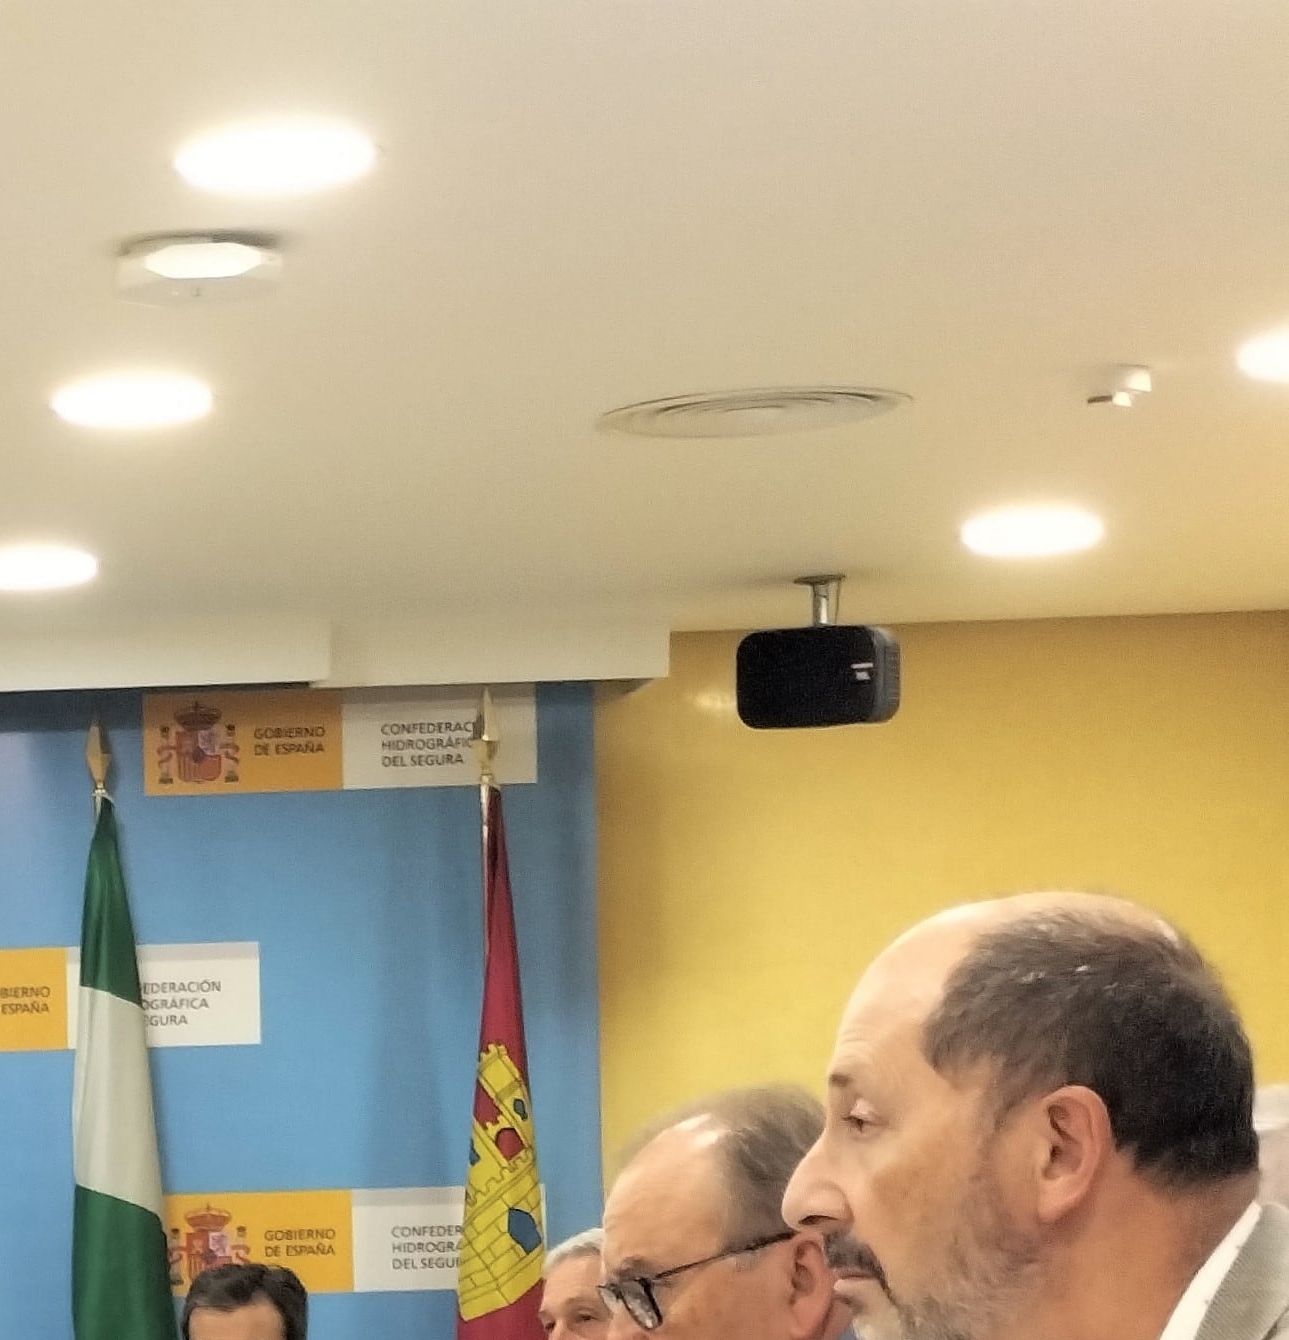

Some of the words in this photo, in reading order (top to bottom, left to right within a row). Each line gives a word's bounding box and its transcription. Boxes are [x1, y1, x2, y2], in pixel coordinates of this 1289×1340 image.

[254, 726, 325, 740] GOBIERNO
[381, 721, 473, 736] CONFEDERAC
[254, 744, 270, 756] DE
[275, 740, 325, 754] ESPAÑA
[382, 737, 473, 751] HIDROGRÁFIC
[382, 755, 407, 767] DEL
[411, 753, 463, 766] SEGURA
[143, 980, 221, 995] EDERACIÓN
[1, 1001, 49, 1015] ESPAÑA
[142, 998, 209, 1010] OGRÁFICA
[149, 1014, 188, 1027] GURA
[264, 1228, 336, 1241] GOBIERNO
[391, 1225, 464, 1238] CONFEDER
[265, 1245, 280, 1257] DE
[286, 1242, 335, 1256] ESPAÑA
[392, 1241, 460, 1254] HIDROGR
[393, 1258, 417, 1270] DEL
[421, 1256, 455, 1268] SEGU
